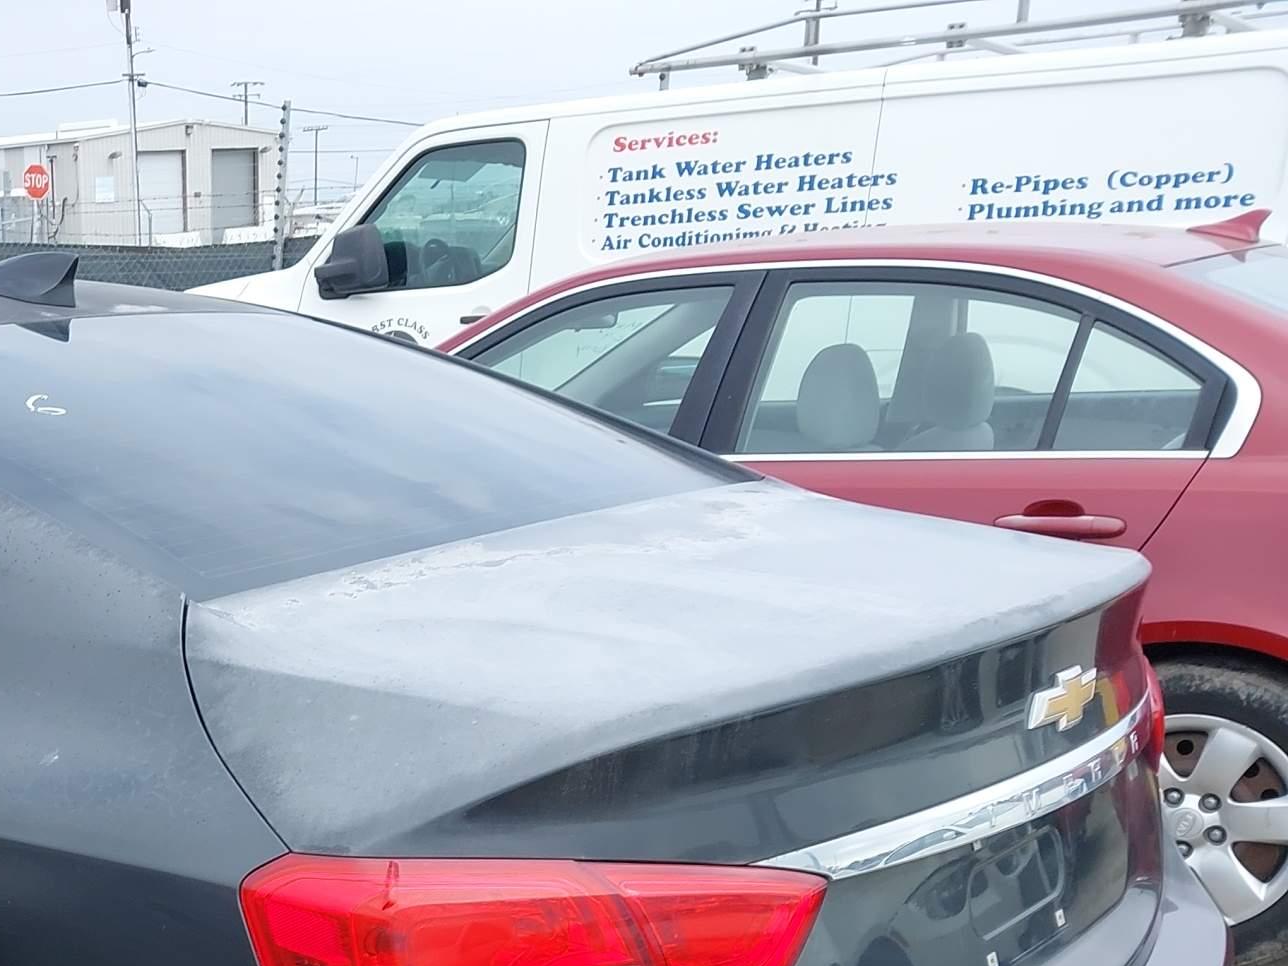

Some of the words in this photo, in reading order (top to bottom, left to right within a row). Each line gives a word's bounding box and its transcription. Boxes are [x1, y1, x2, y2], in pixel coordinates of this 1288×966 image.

[613, 130, 719, 152] Services:
[24, 173, 49, 189] STOP
[608, 164, 667, 183] Tank
[675, 159, 747, 178] Water
[754, 150, 854, 172] Heaters
[969, 174, 1090, 196] Re-Pipes
[1107, 162, 1235, 191] (Copper)
[605, 185, 708, 206] Tankless
[716, 179, 790, 198] Water
[797, 170, 899, 193] Heaters
[604, 207, 729, 229] Trenchless
[736, 199, 817, 220] Sewer
[824, 195, 894, 215] Lines
[967, 198, 1104, 220] Plumbing
[1109, 194, 1165, 214] and
[1173, 191, 1257, 211] more
[601, 233, 633, 251] Air
[397, 317, 431, 340] CLASS
